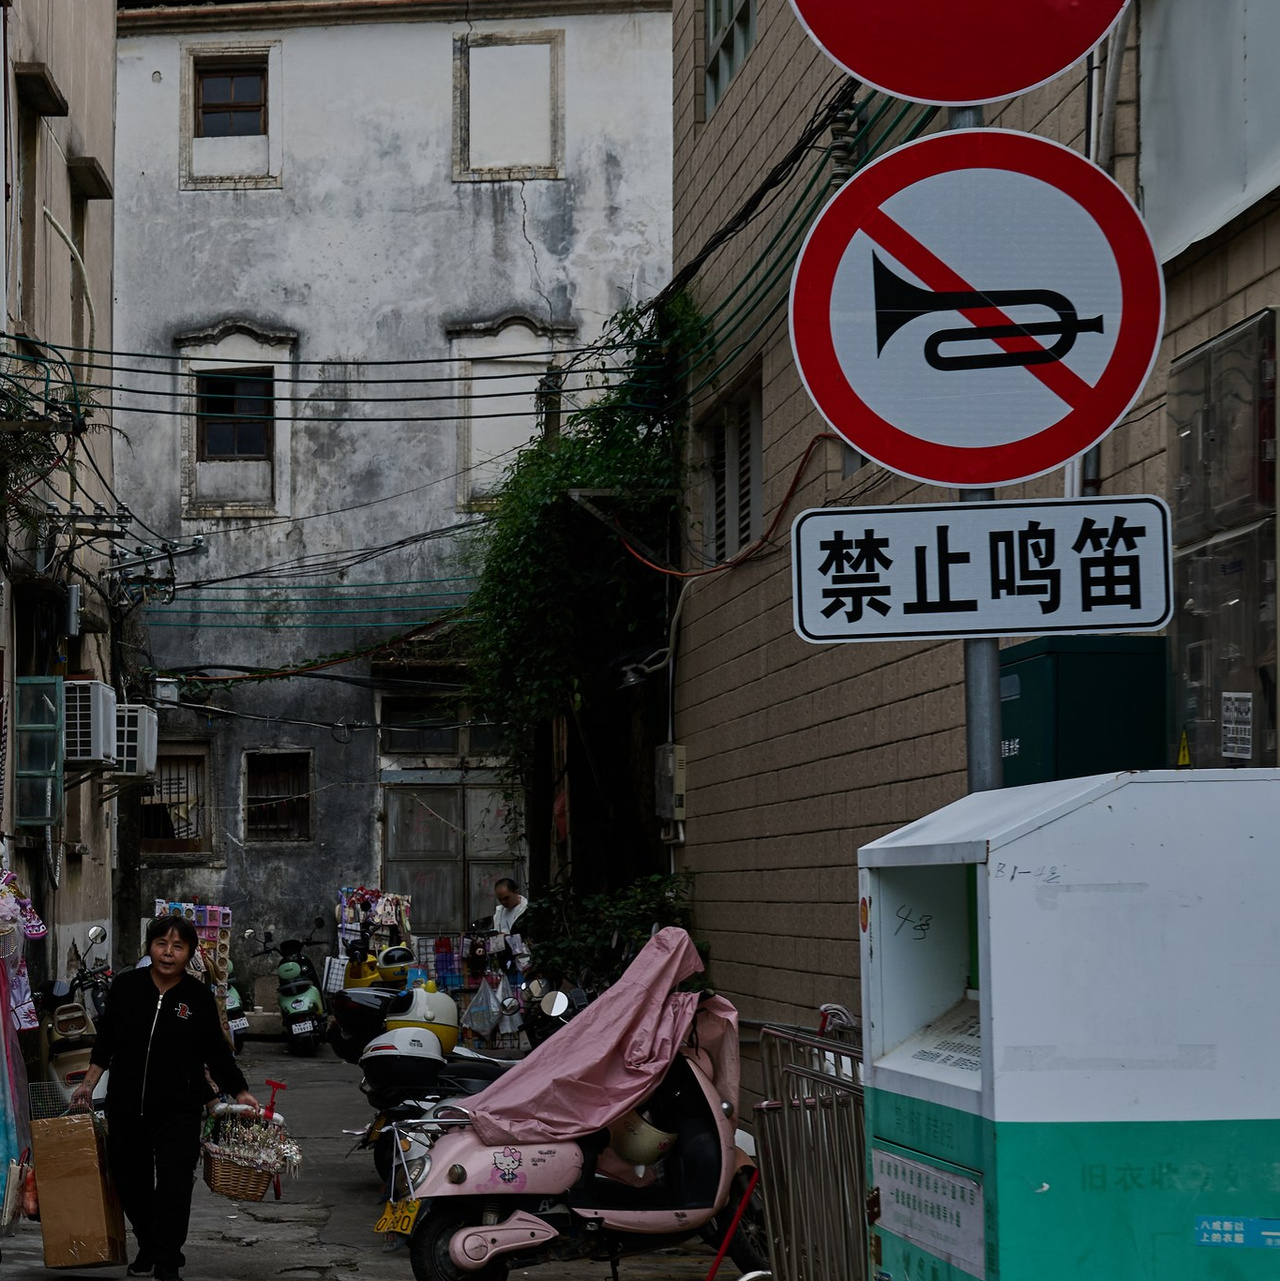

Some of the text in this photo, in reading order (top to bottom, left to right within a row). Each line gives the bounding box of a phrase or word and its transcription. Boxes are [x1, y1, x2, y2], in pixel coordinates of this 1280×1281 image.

[817, 516, 1147, 623] 禁止鸣笛
[1200, 1232, 1245, 1244] 上的衣服
